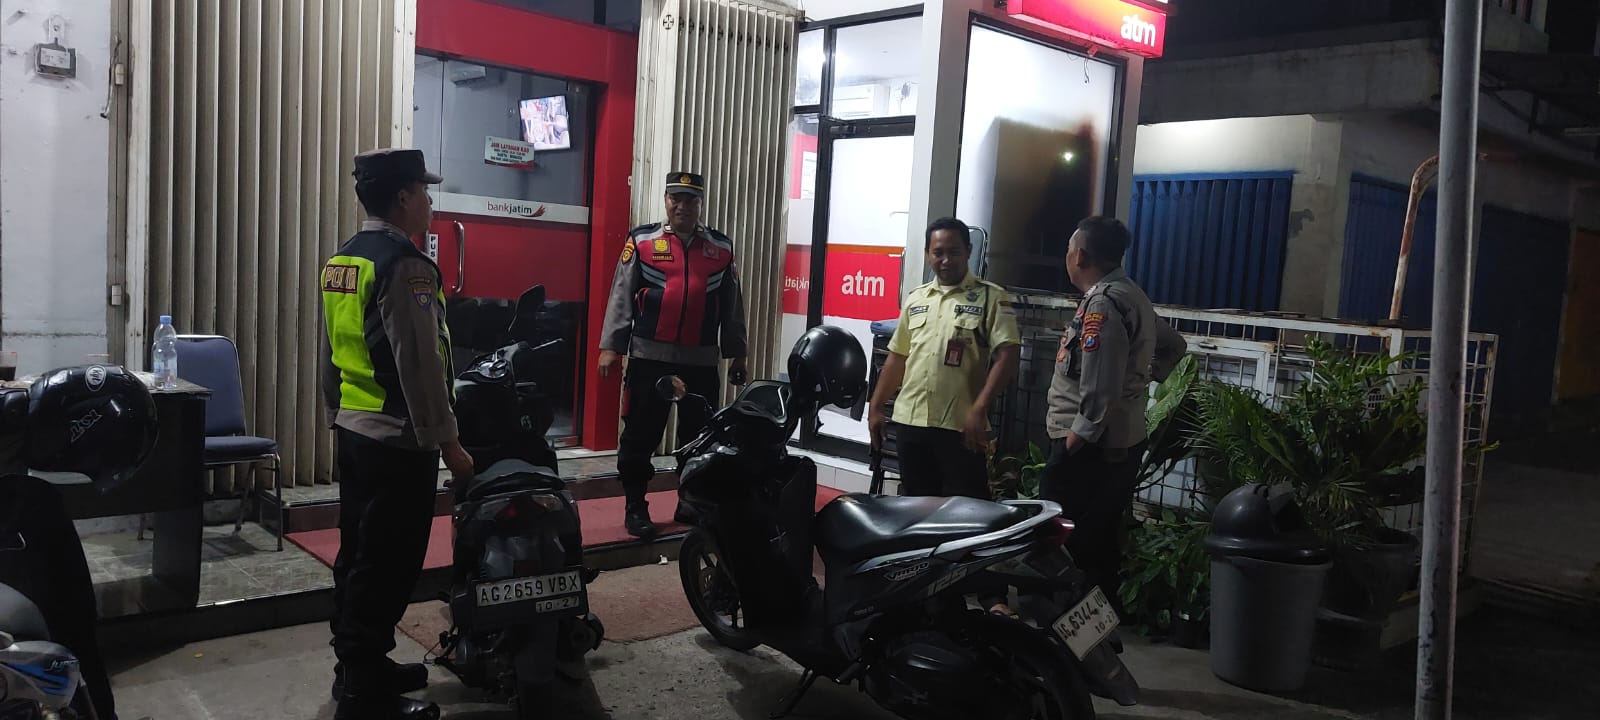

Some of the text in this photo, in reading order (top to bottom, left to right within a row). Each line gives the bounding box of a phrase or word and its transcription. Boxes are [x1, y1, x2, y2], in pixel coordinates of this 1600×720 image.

[1120, 14, 1156, 47] atm
[487, 201, 532, 214] bankjatim
[841, 269, 885, 296] atm
[548, 575, 578, 592] VBX
